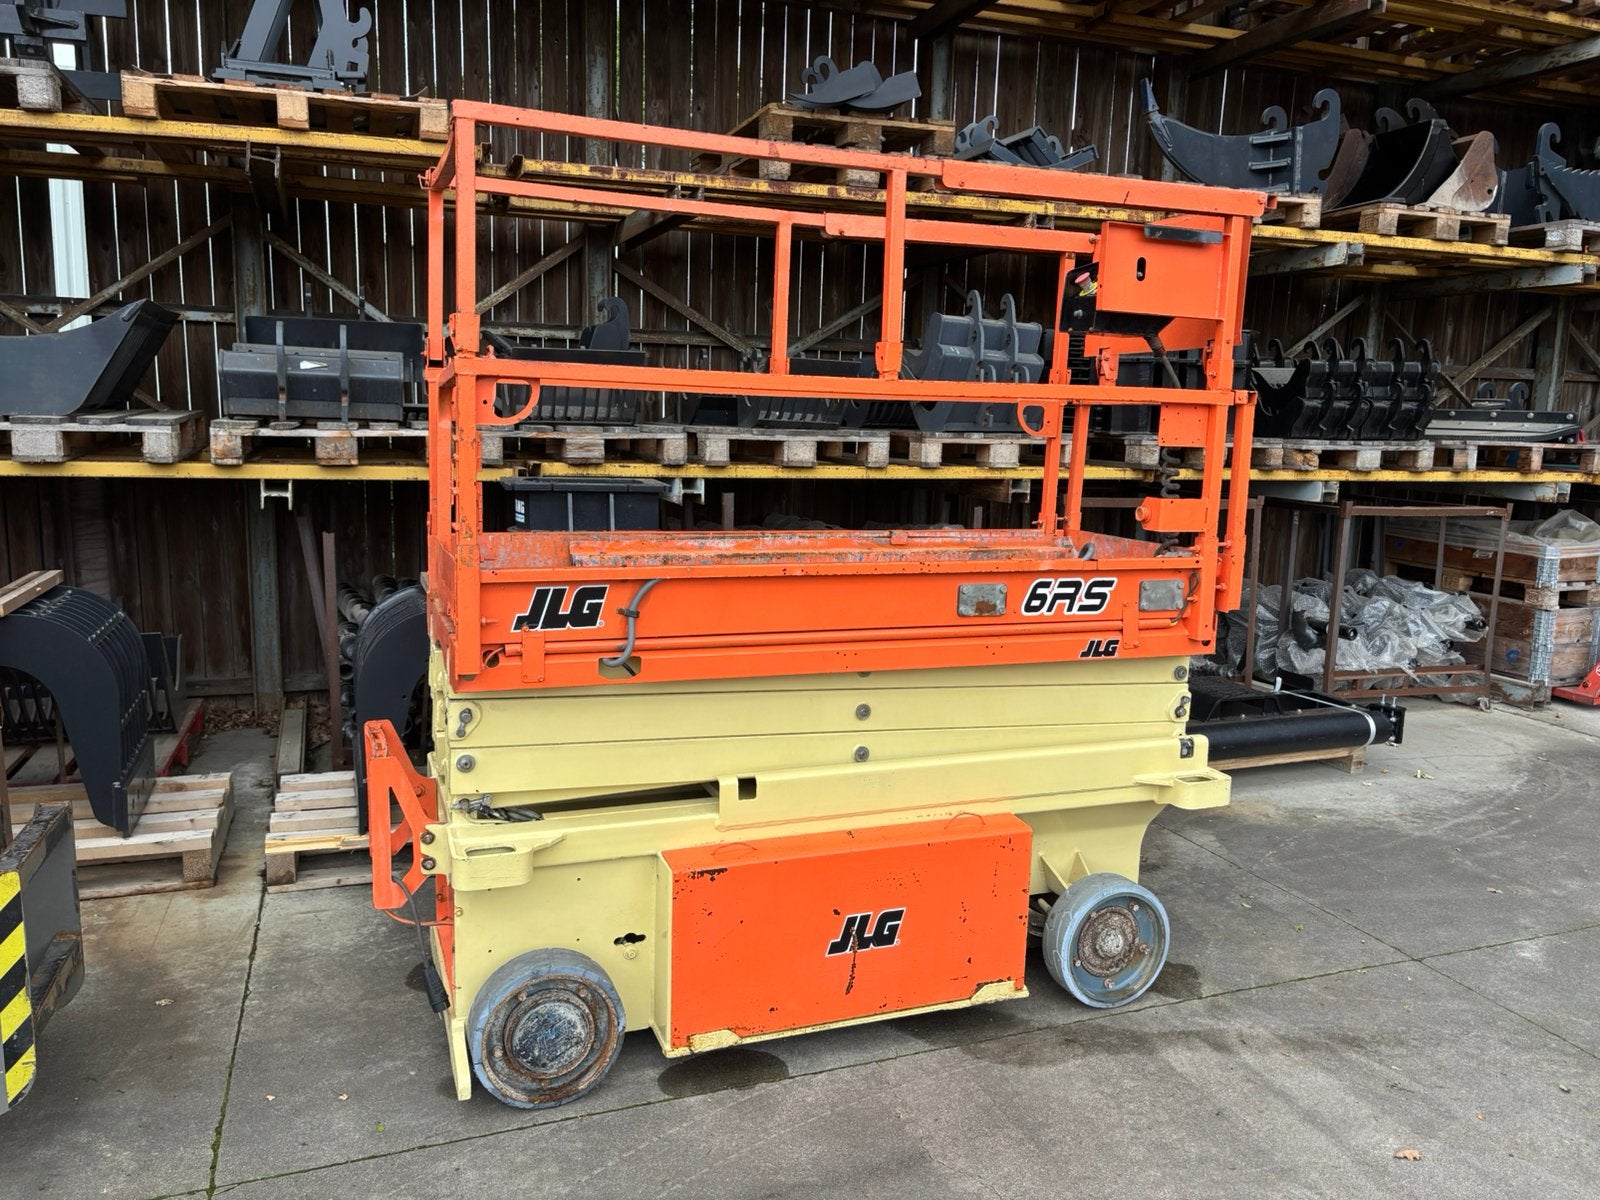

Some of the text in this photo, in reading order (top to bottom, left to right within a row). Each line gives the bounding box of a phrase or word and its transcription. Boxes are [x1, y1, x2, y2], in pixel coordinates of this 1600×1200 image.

[511, 585, 608, 632] JLG
[1021, 577, 1117, 615] 6RS
[1079, 639, 1119, 658] JLG
[826, 907, 905, 956] JLG
